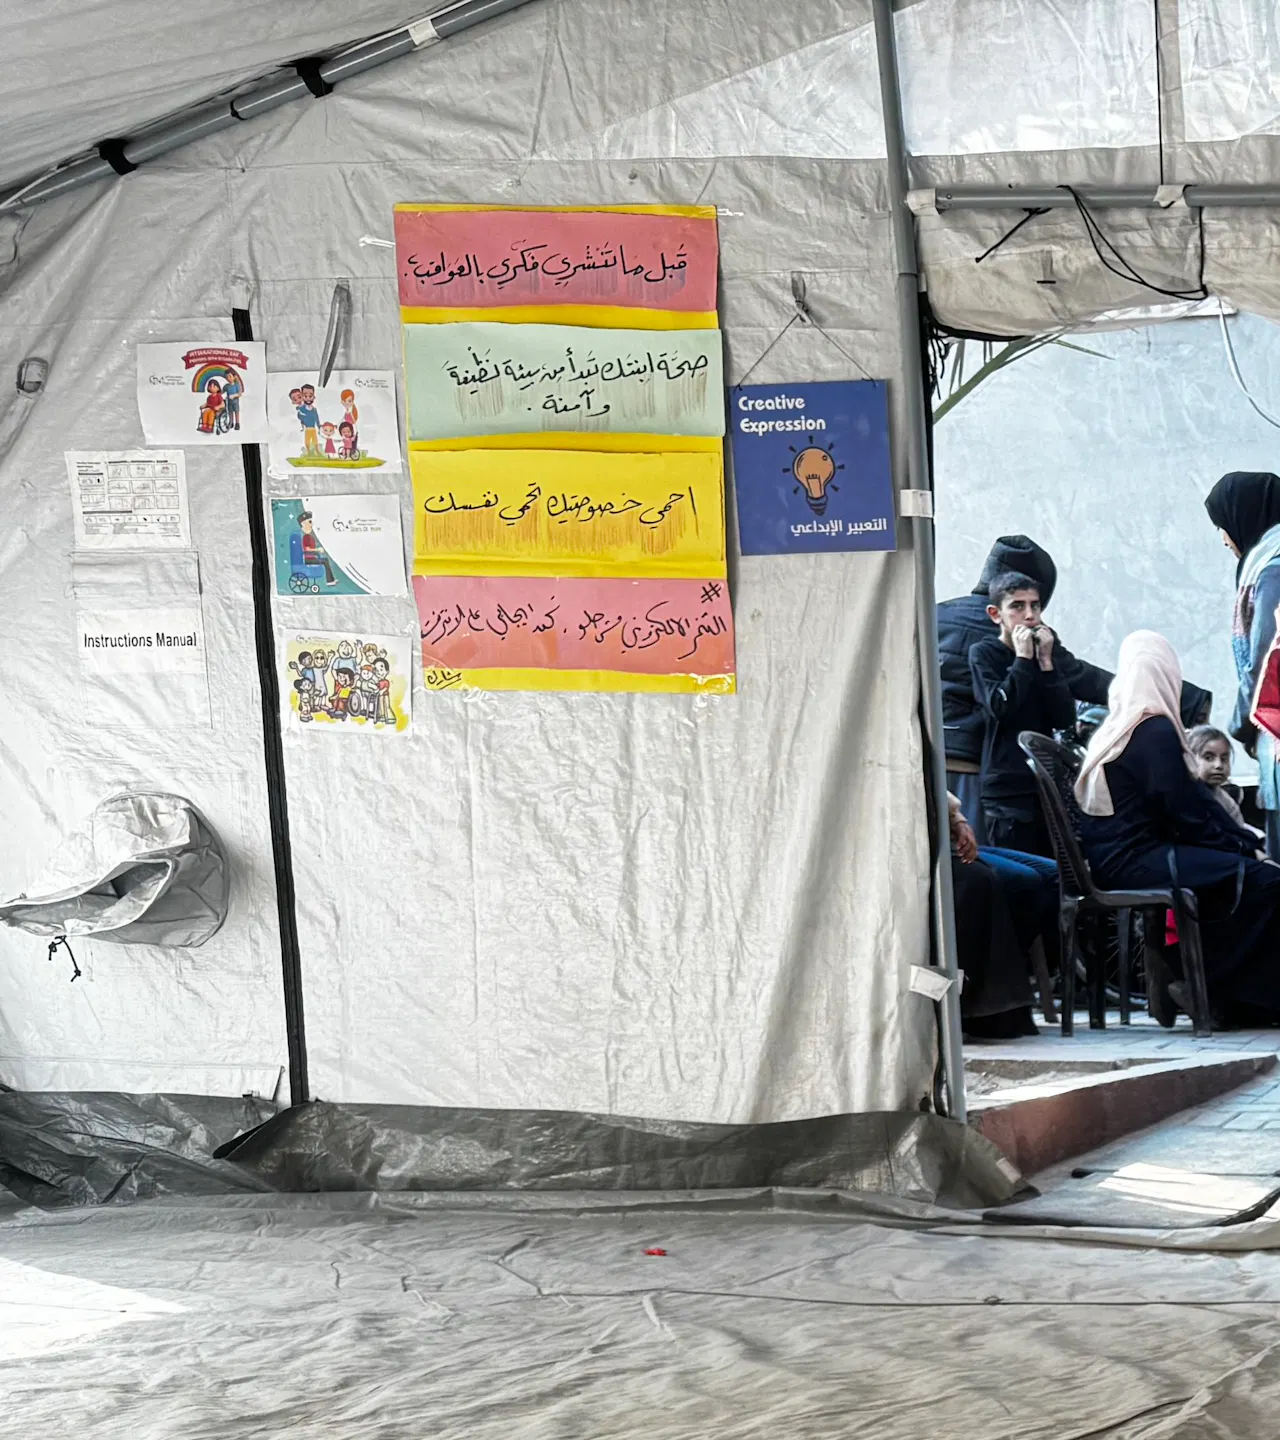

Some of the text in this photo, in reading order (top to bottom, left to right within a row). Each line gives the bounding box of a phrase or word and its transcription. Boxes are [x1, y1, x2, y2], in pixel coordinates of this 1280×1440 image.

[738, 394, 806, 411] Creative
[740, 416, 826, 436] Expression
[790, 518, 887, 536] التعبير الإبداعي
[84, 631, 197, 648] Instructions Manual
